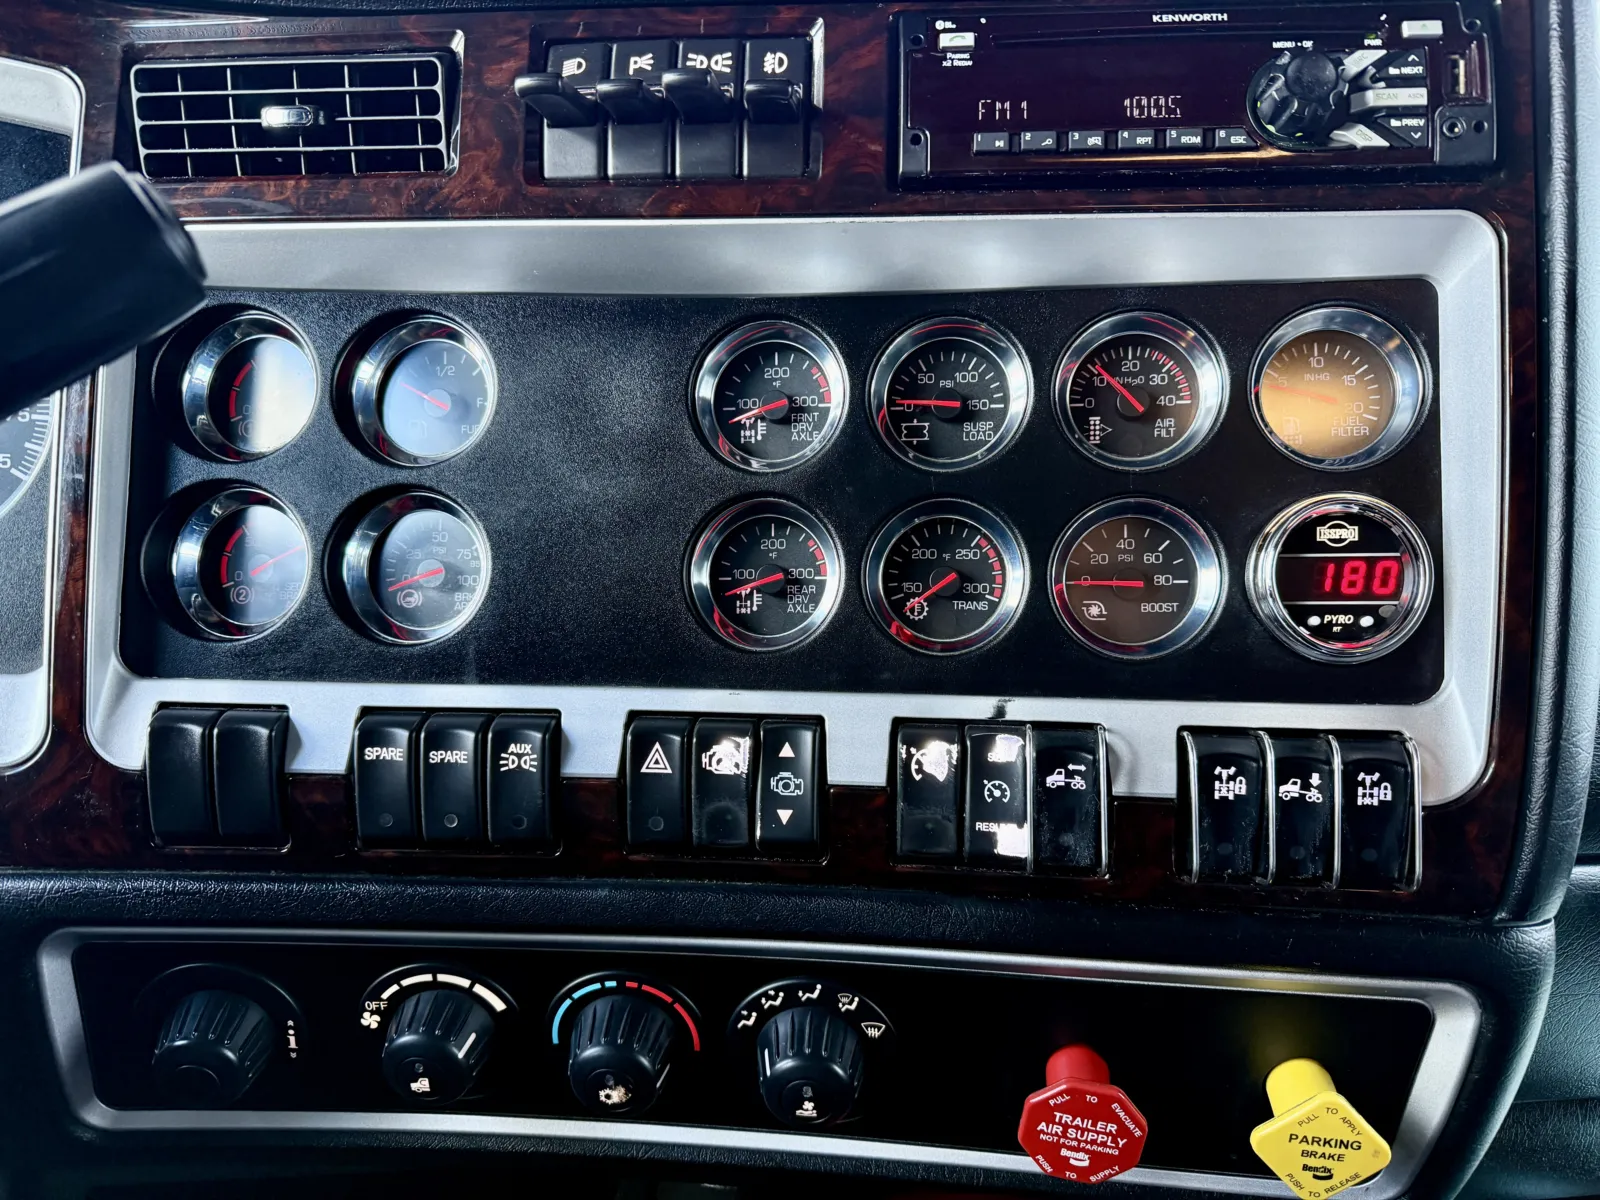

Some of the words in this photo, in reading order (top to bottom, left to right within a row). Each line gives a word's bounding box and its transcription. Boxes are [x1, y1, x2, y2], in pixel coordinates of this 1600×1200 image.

[1152, 13, 1227, 22] KENWORTH
[1364, 38, 1382, 46] PWR
[1401, 66, 1424, 74] NEXT
[1376, 92, 1398, 100] SCAN
[1402, 119, 1425, 127] PREV
[1025, 132, 1032, 140] 2
[1073, 132, 1079, 140] 3
[1136, 136, 1152, 145] RPT
[1170, 130, 1177, 138] 5
[1181, 136, 1201, 144] RDM
[1219, 130, 1226, 138] 6
[1230, 136, 1247, 144] ESC
[1121, 360, 1140, 372] 20
[1308, 357, 1324, 368] 10
[436, 366, 456, 378] 1/2
[764, 368, 790, 378] 200
[954, 372, 978, 382] 100
[918, 373, 934, 384] 50
[1092, 376, 1107, 386] 10
[1150, 374, 1168, 385] 30
[1278, 376, 1288, 388] 5
[1342, 374, 1356, 386] 15
[940, 380, 954, 388] PSI
[736, 399, 759, 409] 100
[792, 396, 818, 407] 300
[966, 400, 990, 410] 150
[1084, 398, 1094, 408] 0
[1156, 395, 1176, 406] 40
[1344, 402, 1364, 414] 20
[791, 412, 820, 422] FRNT
[1334, 416, 1364, 426] FUEL
[791, 422, 814, 432] DRV
[963, 422, 994, 431] SUSP
[1154, 418, 1175, 428] AIR
[1154, 428, 1176, 438] FILT
[1331, 426, 1369, 436] FILTER
[791, 432, 820, 441] AXLE
[963, 432, 994, 441] LOAD
[432, 532, 448, 542] 50
[1320, 529, 1355, 539] ISSPRO
[760, 538, 786, 550] 200
[1116, 538, 1135, 550] 40
[406, 550, 422, 559] 25
[432, 546, 446, 554] PSI
[456, 549, 472, 560] 75
[912, 548, 938, 560] 200
[956, 548, 980, 560] 250
[1090, 554, 1108, 564] 20
[1118, 554, 1134, 562] PSI
[1144, 552, 1162, 564] 60
[234, 571, 244, 581] 0
[732, 568, 755, 580] 100
[788, 568, 814, 579] 300
[1324, 560, 1399, 595] 180
[457, 574, 480, 586] 100
[1154, 575, 1172, 586] 80
[788, 585, 816, 594] REAR
[902, 582, 922, 592] 150
[962, 583, 990, 594] 300
[788, 594, 810, 604] DRV
[787, 604, 816, 614] AXLE
[952, 601, 988, 610] TRANS
[1141, 602, 1179, 612] BOOST
[1324, 614, 1354, 624] PYRO
[364, 747, 404, 761] SPARE
[508, 744, 532, 754] AUX
[428, 750, 468, 764] SPARE
[365, 1001, 388, 1011] OFF
[1048, 1094, 1070, 1106] PULL
[1086, 1094, 1098, 1103] TO
[1111, 1103, 1143, 1138] EVACUATE
[1054, 1112, 1118, 1134] TRAILER
[1298, 1114, 1320, 1128] PULL
[1326, 1107, 1338, 1115] TO
[1340, 1116, 1363, 1137] APPLY
[1036, 1122, 1062, 1136] AIR
[1066, 1128, 1128, 1148] SUPPLY
[1040, 1134, 1058, 1142] NOT
[1060, 1138, 1078, 1148] FOR
[1080, 1142, 1119, 1156] PARKING
[1288, 1134, 1362, 1151] PARKING
[1060, 1148, 1090, 1160] Bendix
[1300, 1150, 1346, 1162] BRAKE
[1036, 1154, 1054, 1173] PUSH
[1065, 1171, 1077, 1179] TO
[1090, 1165, 1120, 1182] SUPPLY
[1302, 1164, 1333, 1174] Bendix
[1286, 1172, 1305, 1191] PUSH
[1308, 1190, 1321, 1198] TO
[1324, 1172, 1362, 1194] RELEASE
